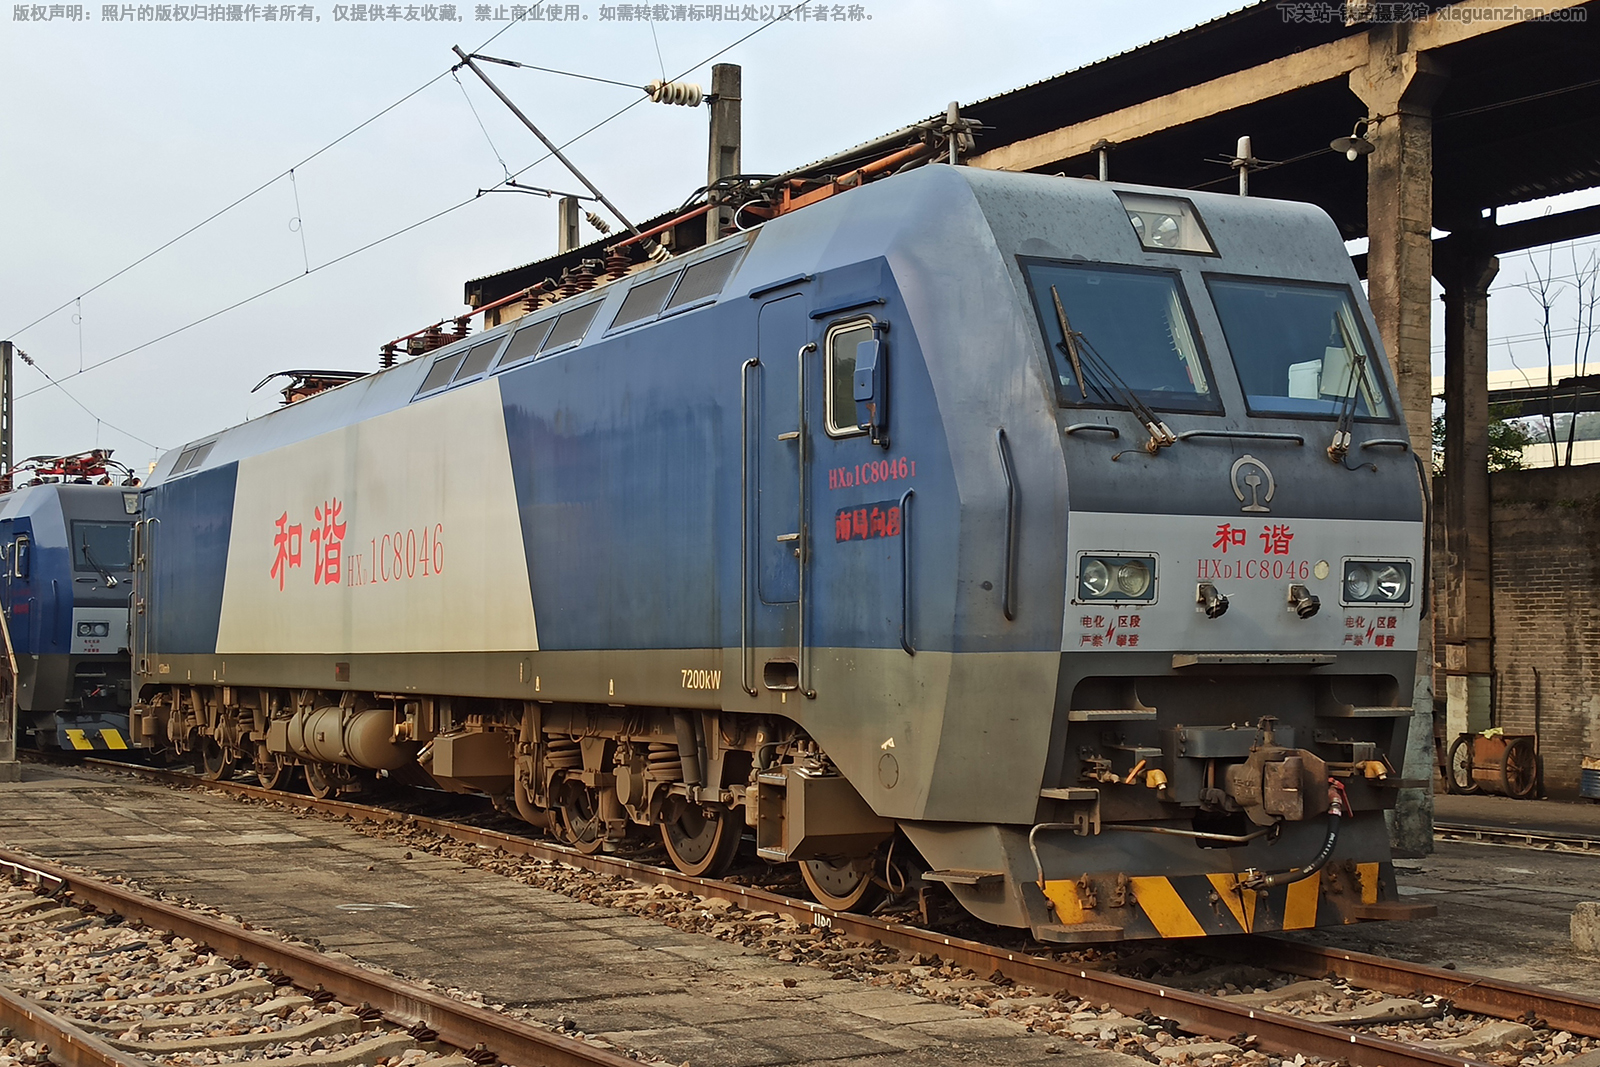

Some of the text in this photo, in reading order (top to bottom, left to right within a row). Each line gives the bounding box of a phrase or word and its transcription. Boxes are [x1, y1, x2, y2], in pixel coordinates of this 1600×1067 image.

[270, 496, 347, 592] 和谐
[1212, 522, 1295, 555] 和谐
[1197, 558, 1310, 580] HXD1C8046
[1081, 615, 1141, 629] 电化 区段
[681, 669, 721, 690] 7200kW
